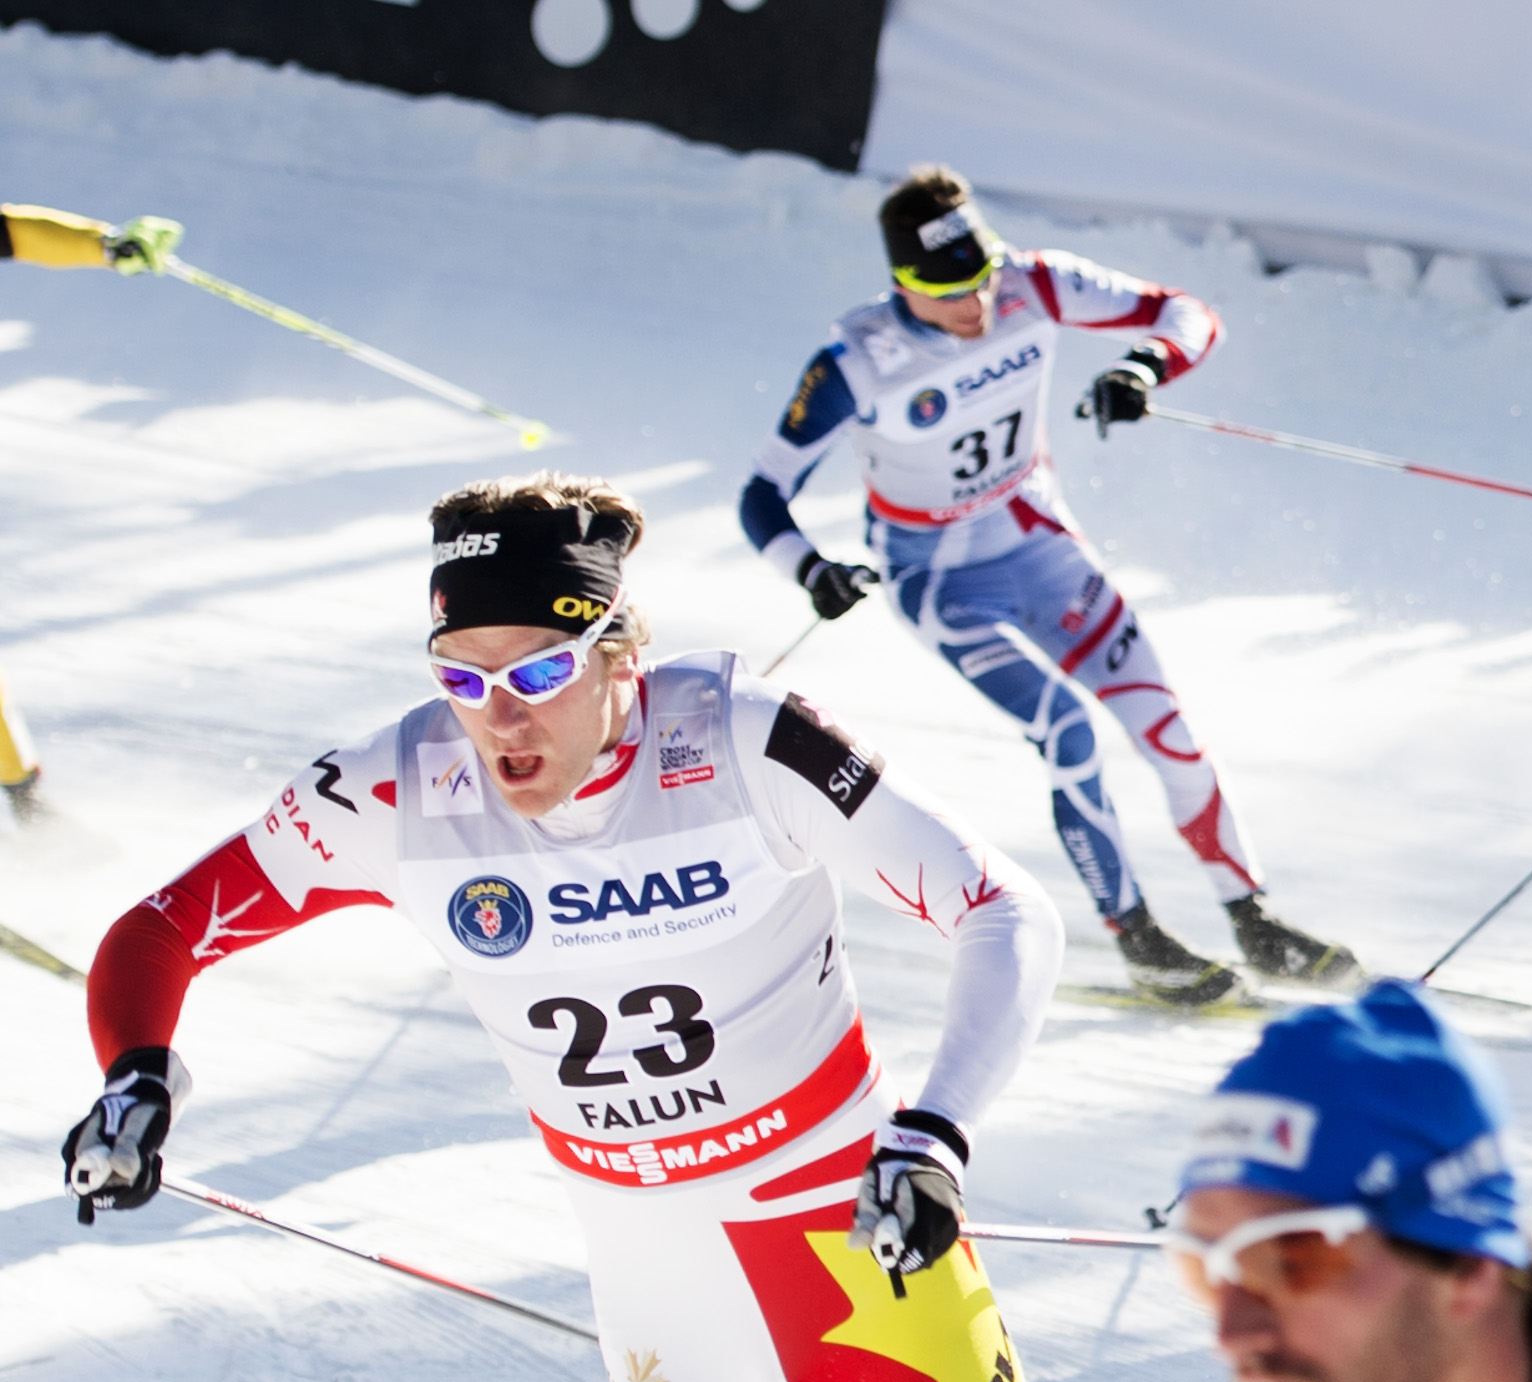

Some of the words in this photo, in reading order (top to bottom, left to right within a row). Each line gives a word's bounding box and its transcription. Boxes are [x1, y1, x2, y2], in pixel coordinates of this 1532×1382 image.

[953, 345, 1041, 396] SAAB
[951, 410, 1021, 479] 37
[466, 882, 510, 900] SAAB
[548, 860, 730, 925] SAAB
[552, 923, 622, 948] Defence
[627, 923, 660, 940] and
[664, 902, 737, 936] Security
[527, 984, 716, 1087] 23
[577, 1080, 726, 1129] FALUN
[567, 1109, 788, 1185] VIESSMANN
